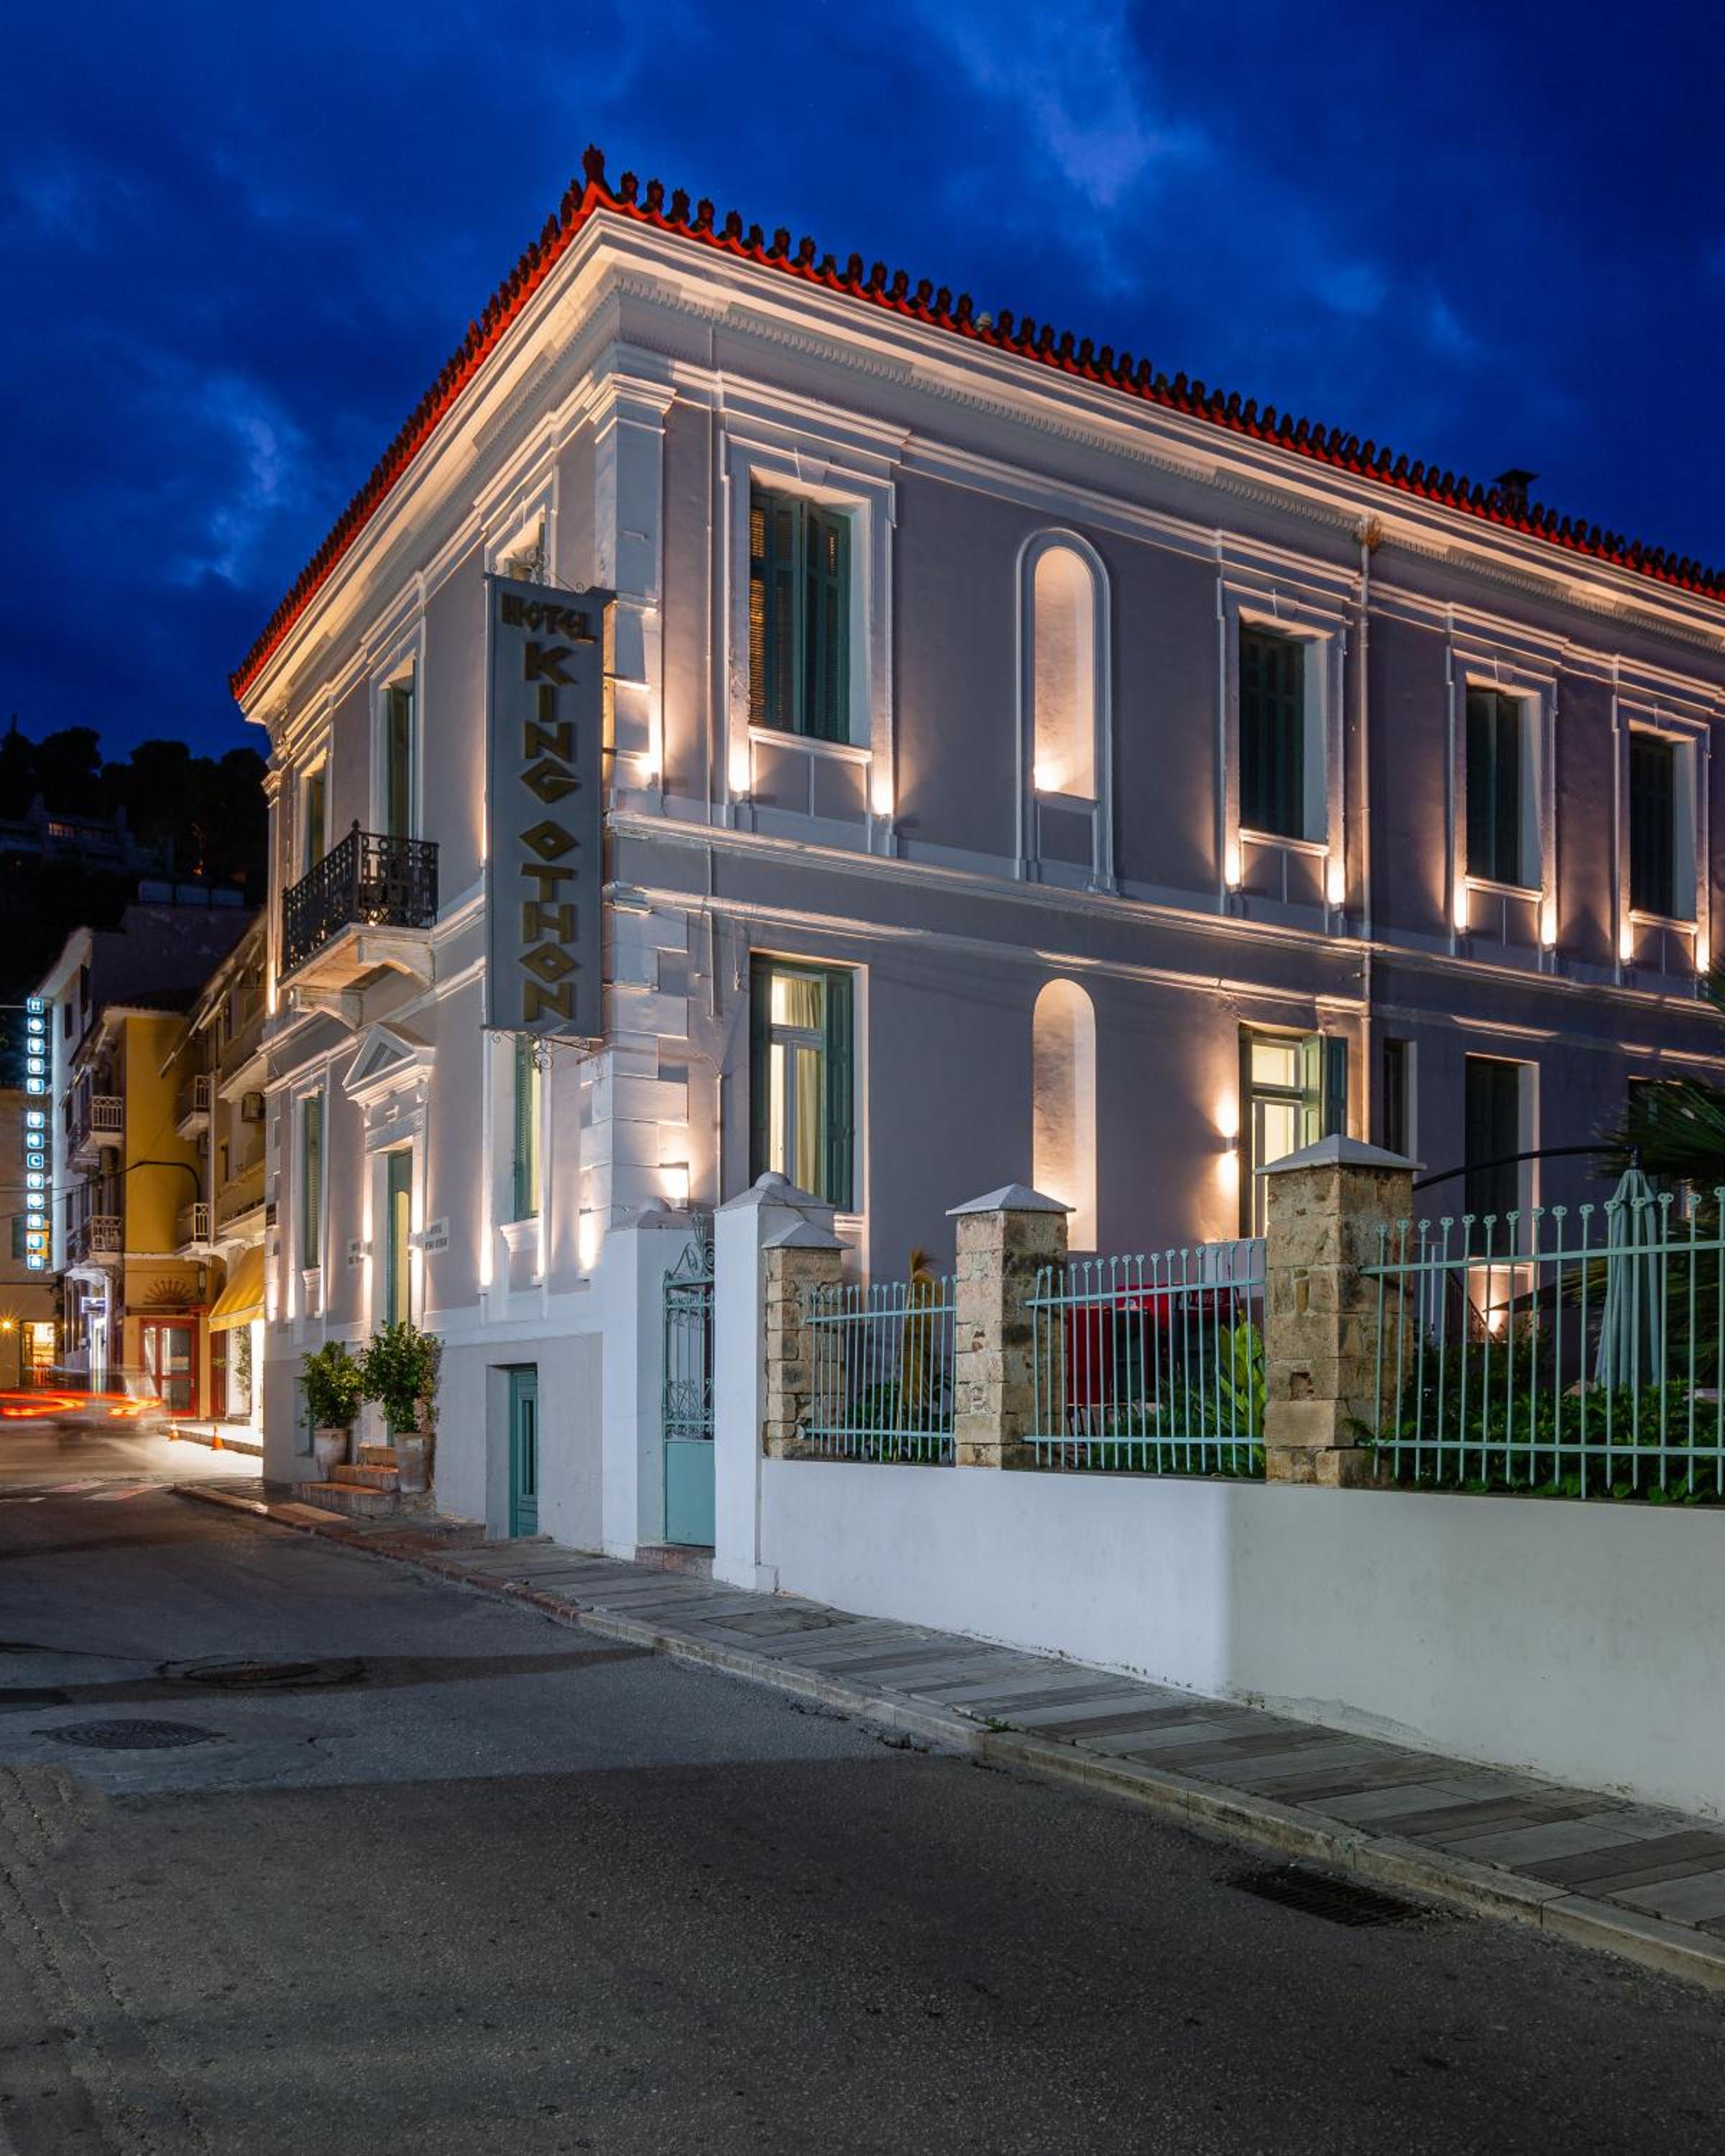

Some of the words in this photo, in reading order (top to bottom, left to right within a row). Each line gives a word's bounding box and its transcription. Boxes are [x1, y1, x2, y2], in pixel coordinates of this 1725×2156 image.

[502, 593, 598, 643] HOTEL
[520, 640, 581, 804] KING
[519, 819, 581, 1022] OTHON
